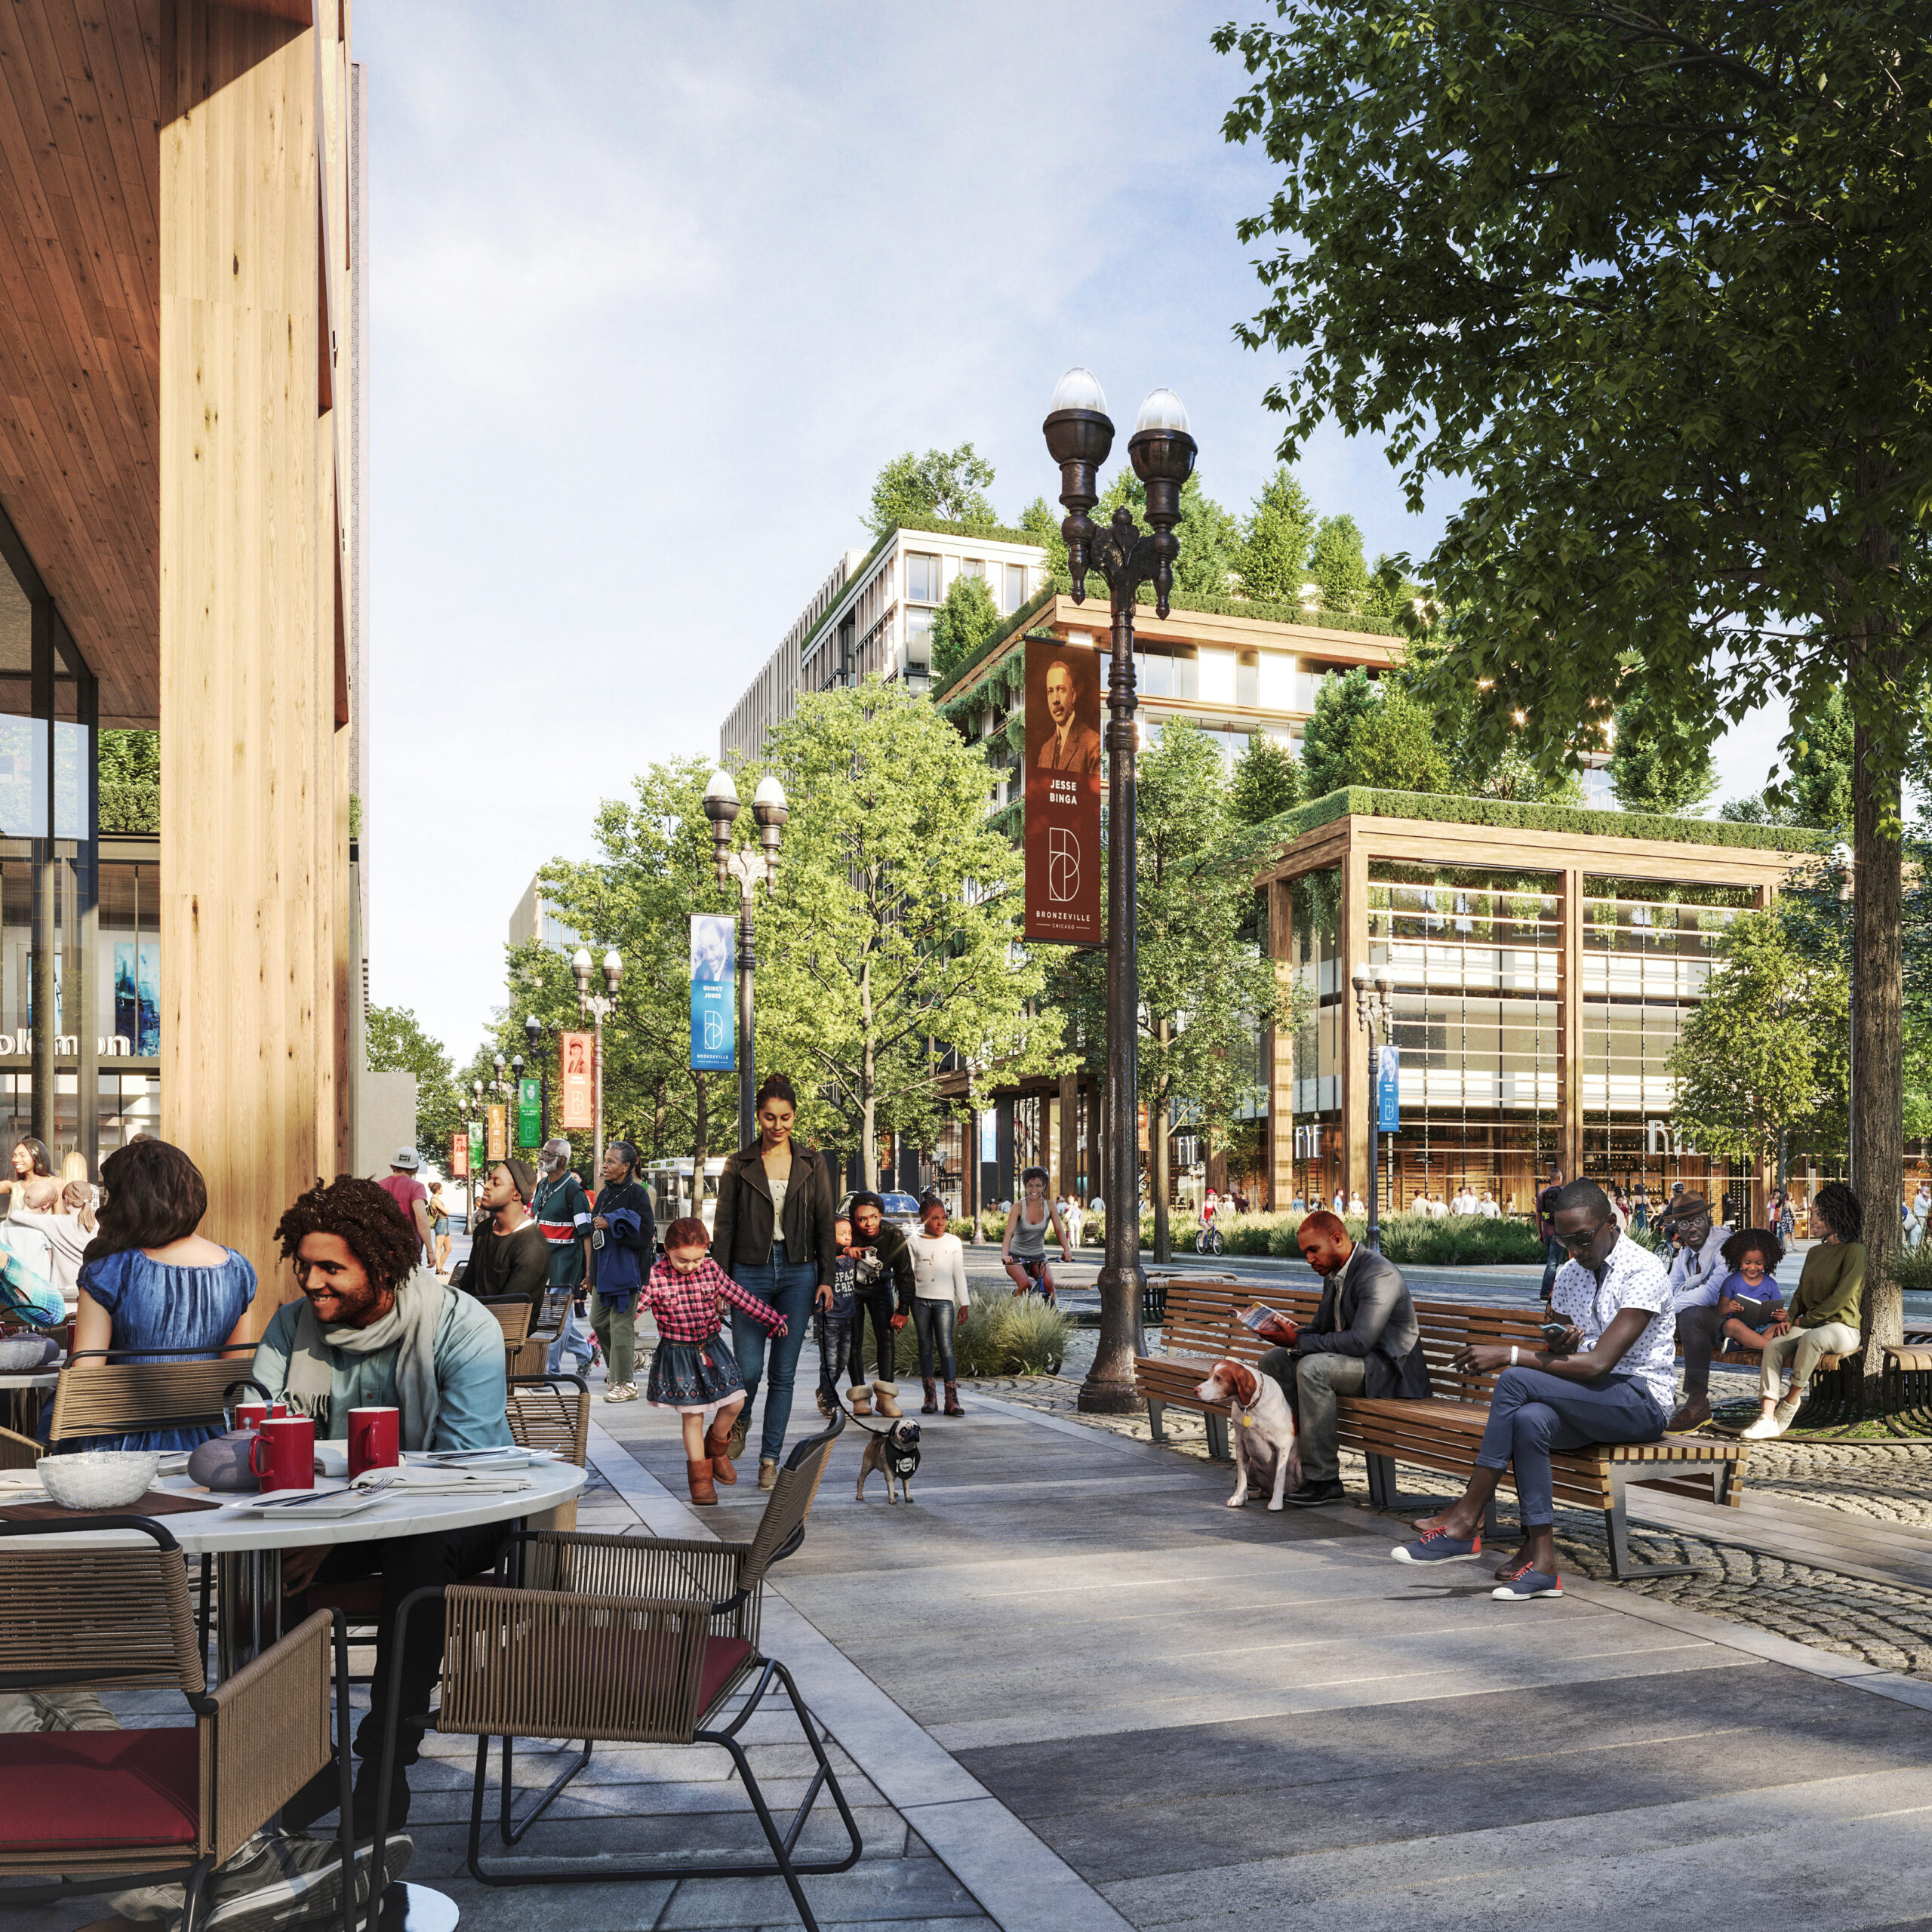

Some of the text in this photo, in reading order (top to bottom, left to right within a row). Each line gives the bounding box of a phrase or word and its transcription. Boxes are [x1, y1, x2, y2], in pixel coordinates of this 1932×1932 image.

[1050, 779, 1077, 791] JESSE
[1050, 792, 1078, 805] BINGA
[1035, 910, 1091, 922] BRONZEVILLE
